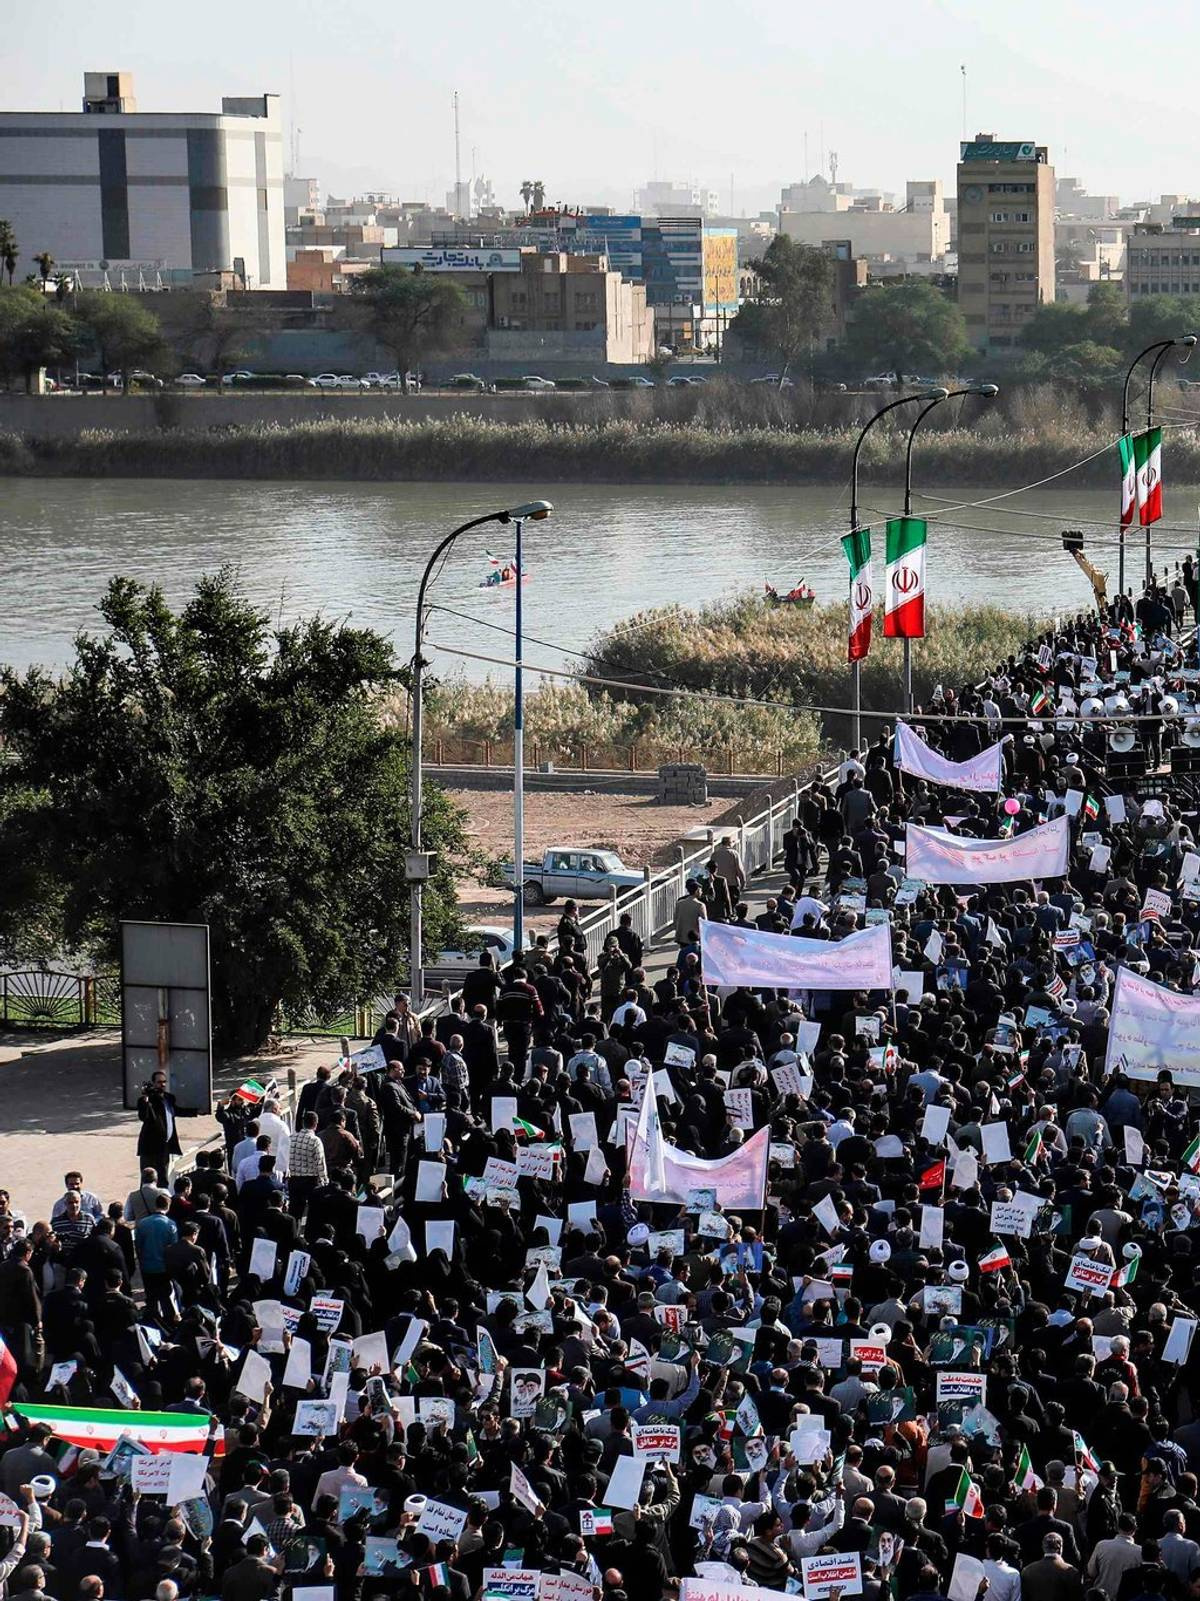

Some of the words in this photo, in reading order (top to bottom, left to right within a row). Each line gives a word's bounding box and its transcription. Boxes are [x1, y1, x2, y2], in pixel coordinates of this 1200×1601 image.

[421, 251, 464, 267] تجارت
[453, 255, 484, 270] بانک
[637, 1437, 658, 1449] منافق
[423, 1522, 439, 1532] است
[807, 1558, 837, 1570] اقتصادی
[808, 1573, 821, 1581] است
[821, 1571, 839, 1580] انقلاب
[839, 1569, 856, 1578] دشمن
[488, 1583, 514, 1594] انگلیس
[519, 1585, 535, 1596] مرگ
